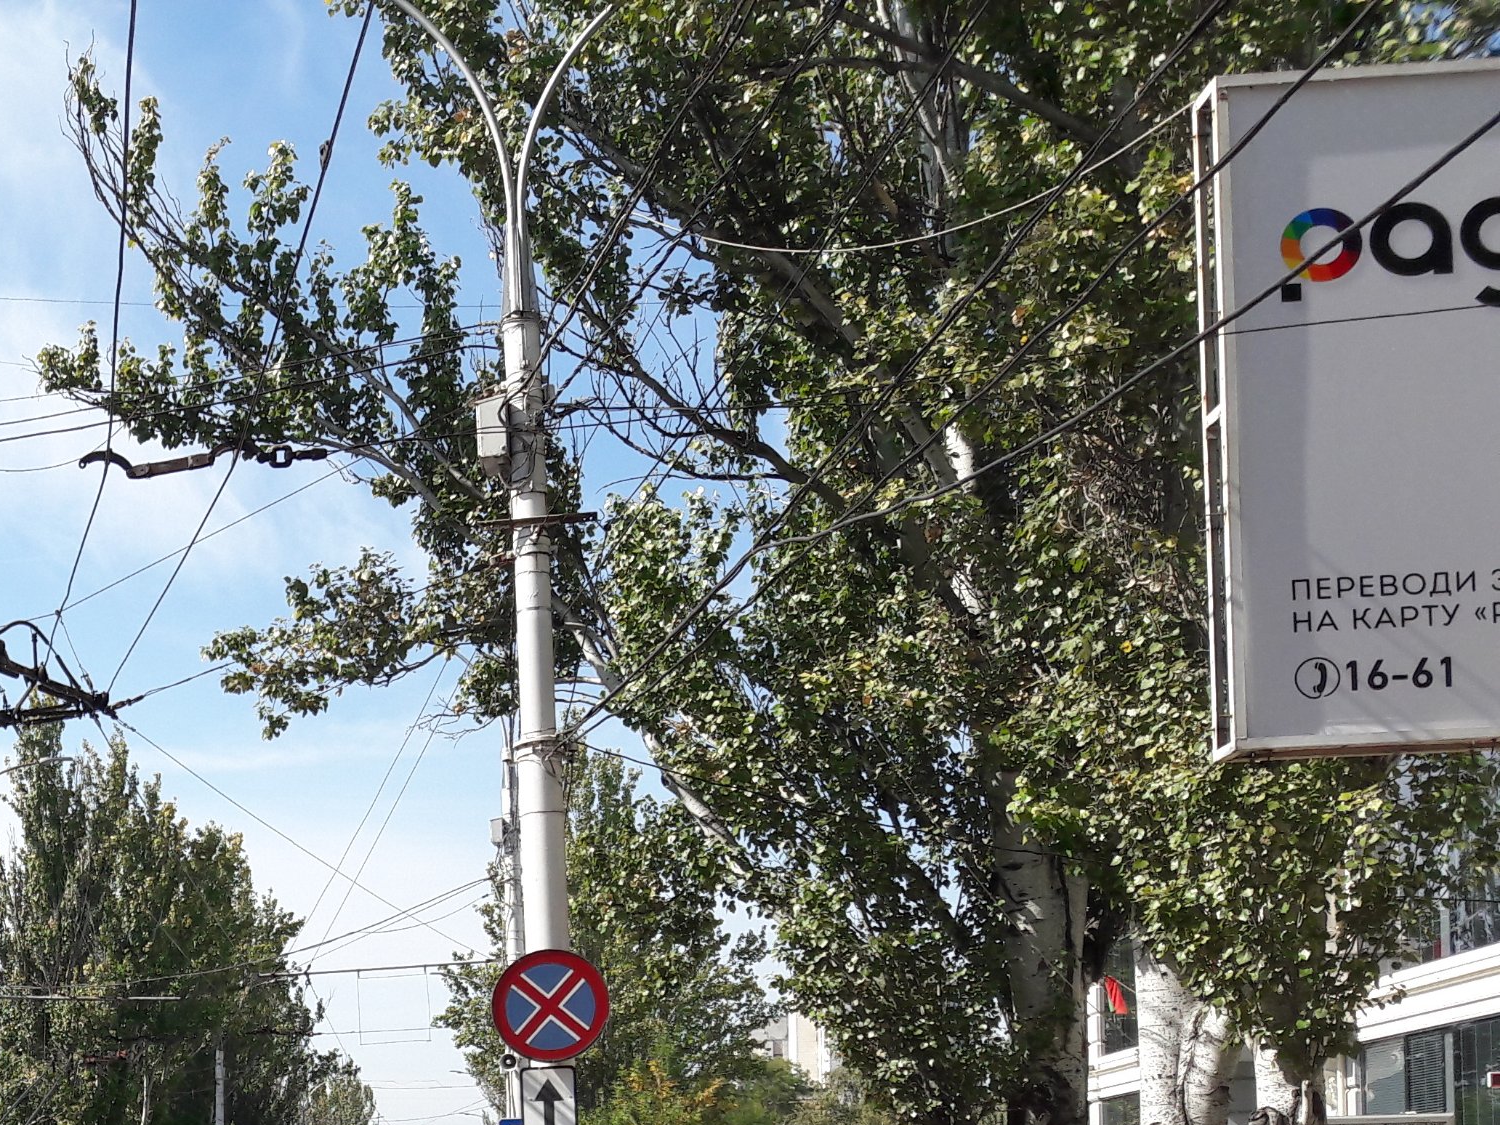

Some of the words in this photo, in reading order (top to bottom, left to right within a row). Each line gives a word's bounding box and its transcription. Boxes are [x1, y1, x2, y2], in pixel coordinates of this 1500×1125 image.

[1291, 570, 1476, 601] ПЕРЕВОДИ
[1293, 609, 1339, 634] НА
[1352, 603, 1460, 630] КАРТУ
[1345, 656, 1453, 692] 16-61
